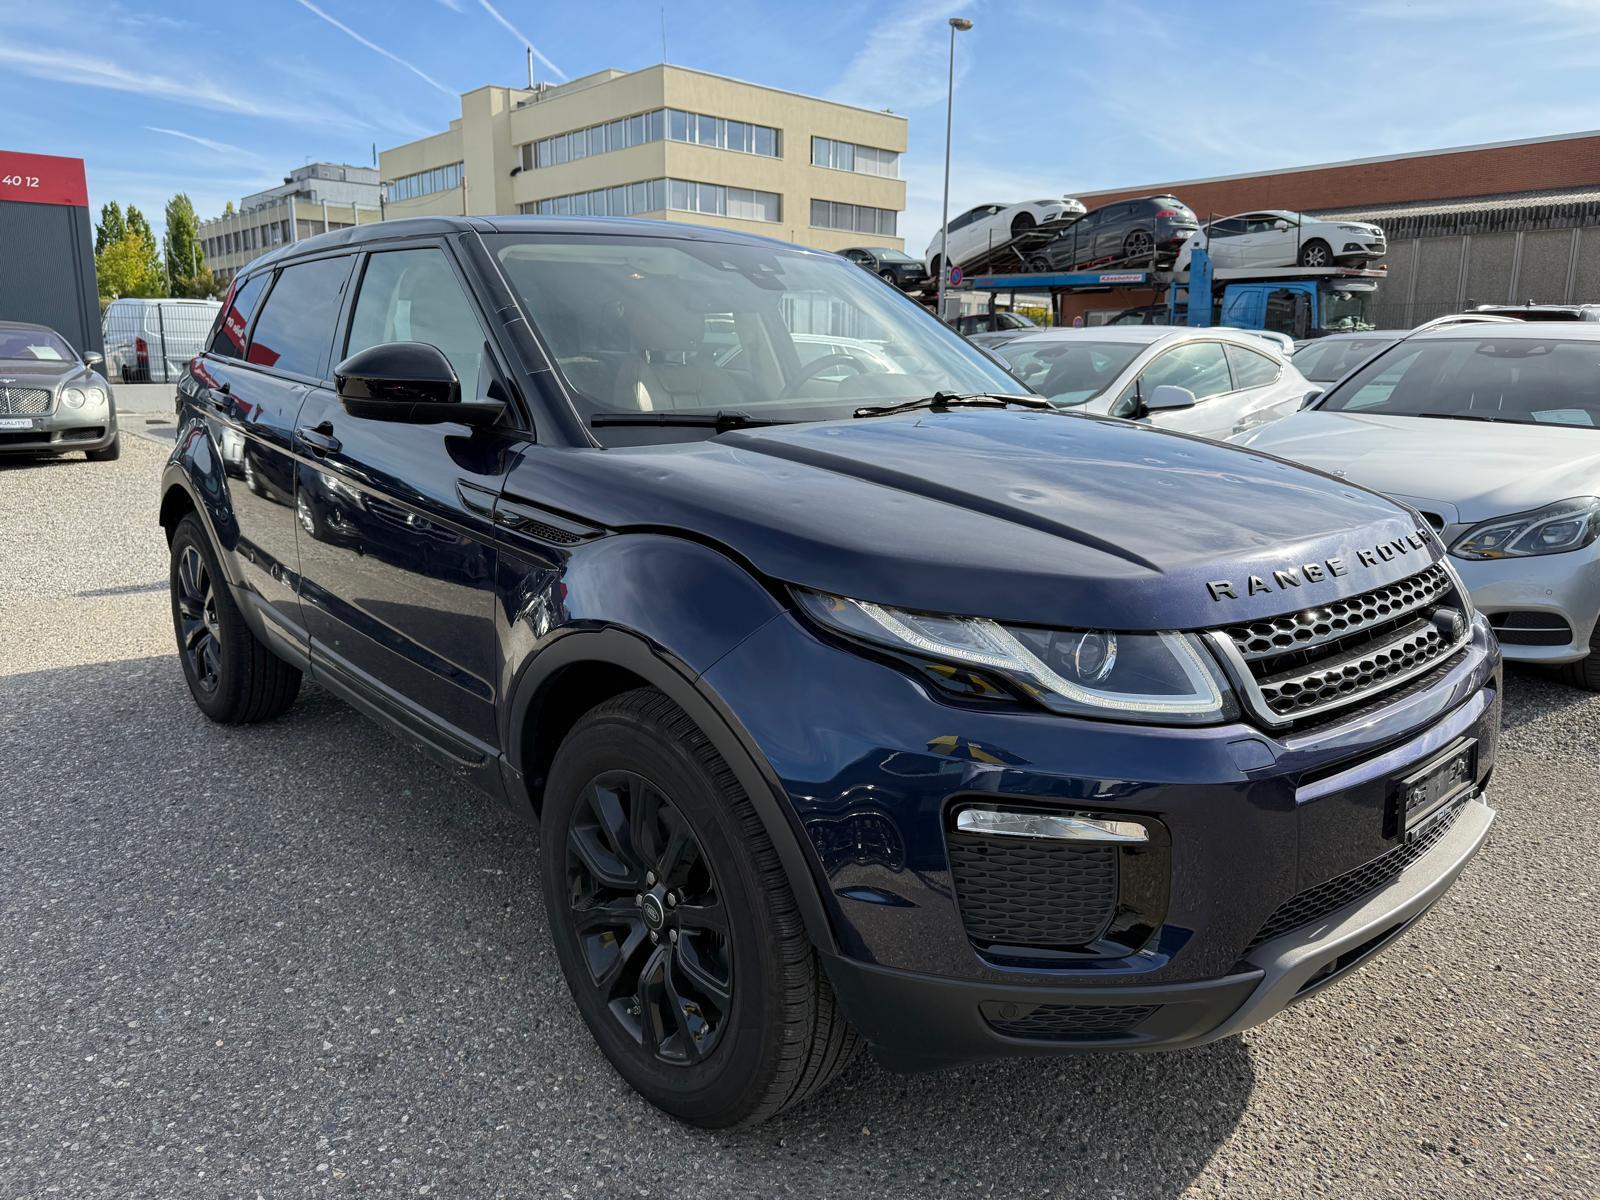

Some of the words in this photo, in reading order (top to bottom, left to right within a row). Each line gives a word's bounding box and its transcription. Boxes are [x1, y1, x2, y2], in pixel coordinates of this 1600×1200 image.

[2, 174, 22, 186] 40
[25, 176, 40, 188] 12
[1206, 557, 1349, 601] RANGE
[1356, 528, 1432, 568] ROVER
